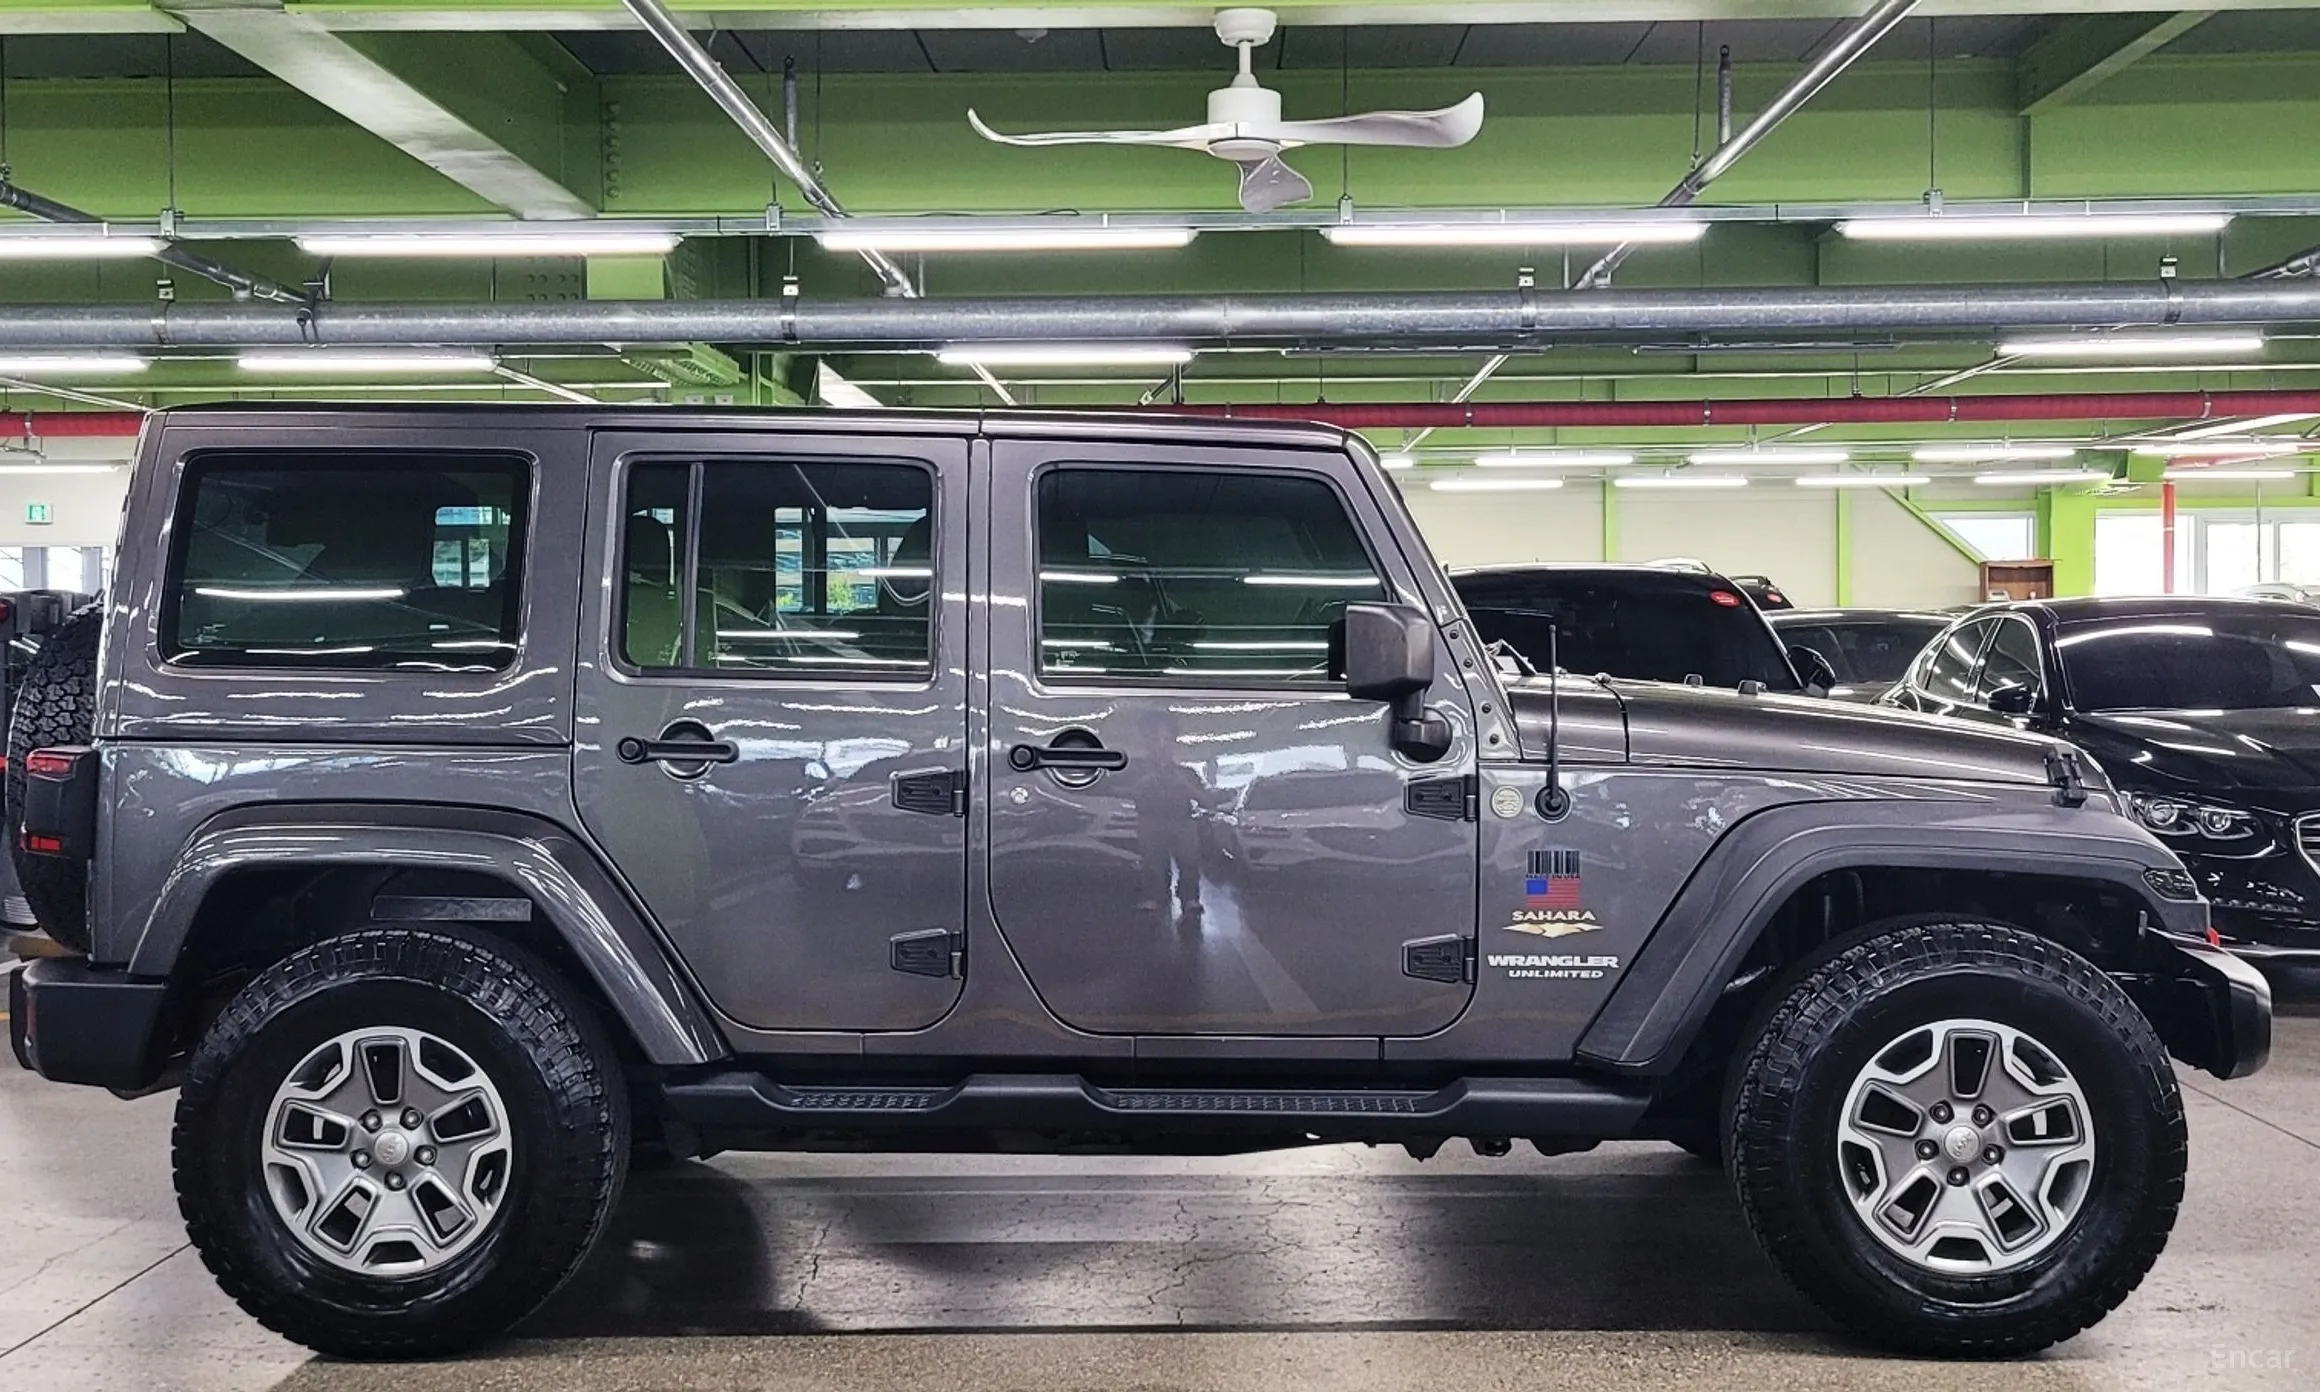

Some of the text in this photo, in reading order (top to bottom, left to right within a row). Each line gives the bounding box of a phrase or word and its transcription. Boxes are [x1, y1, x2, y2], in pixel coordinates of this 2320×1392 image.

[1512, 910, 1596, 921] SAHARA
[1487, 954, 1620, 968] WRANGLER
[1508, 970, 1604, 979] UNLIMITED
